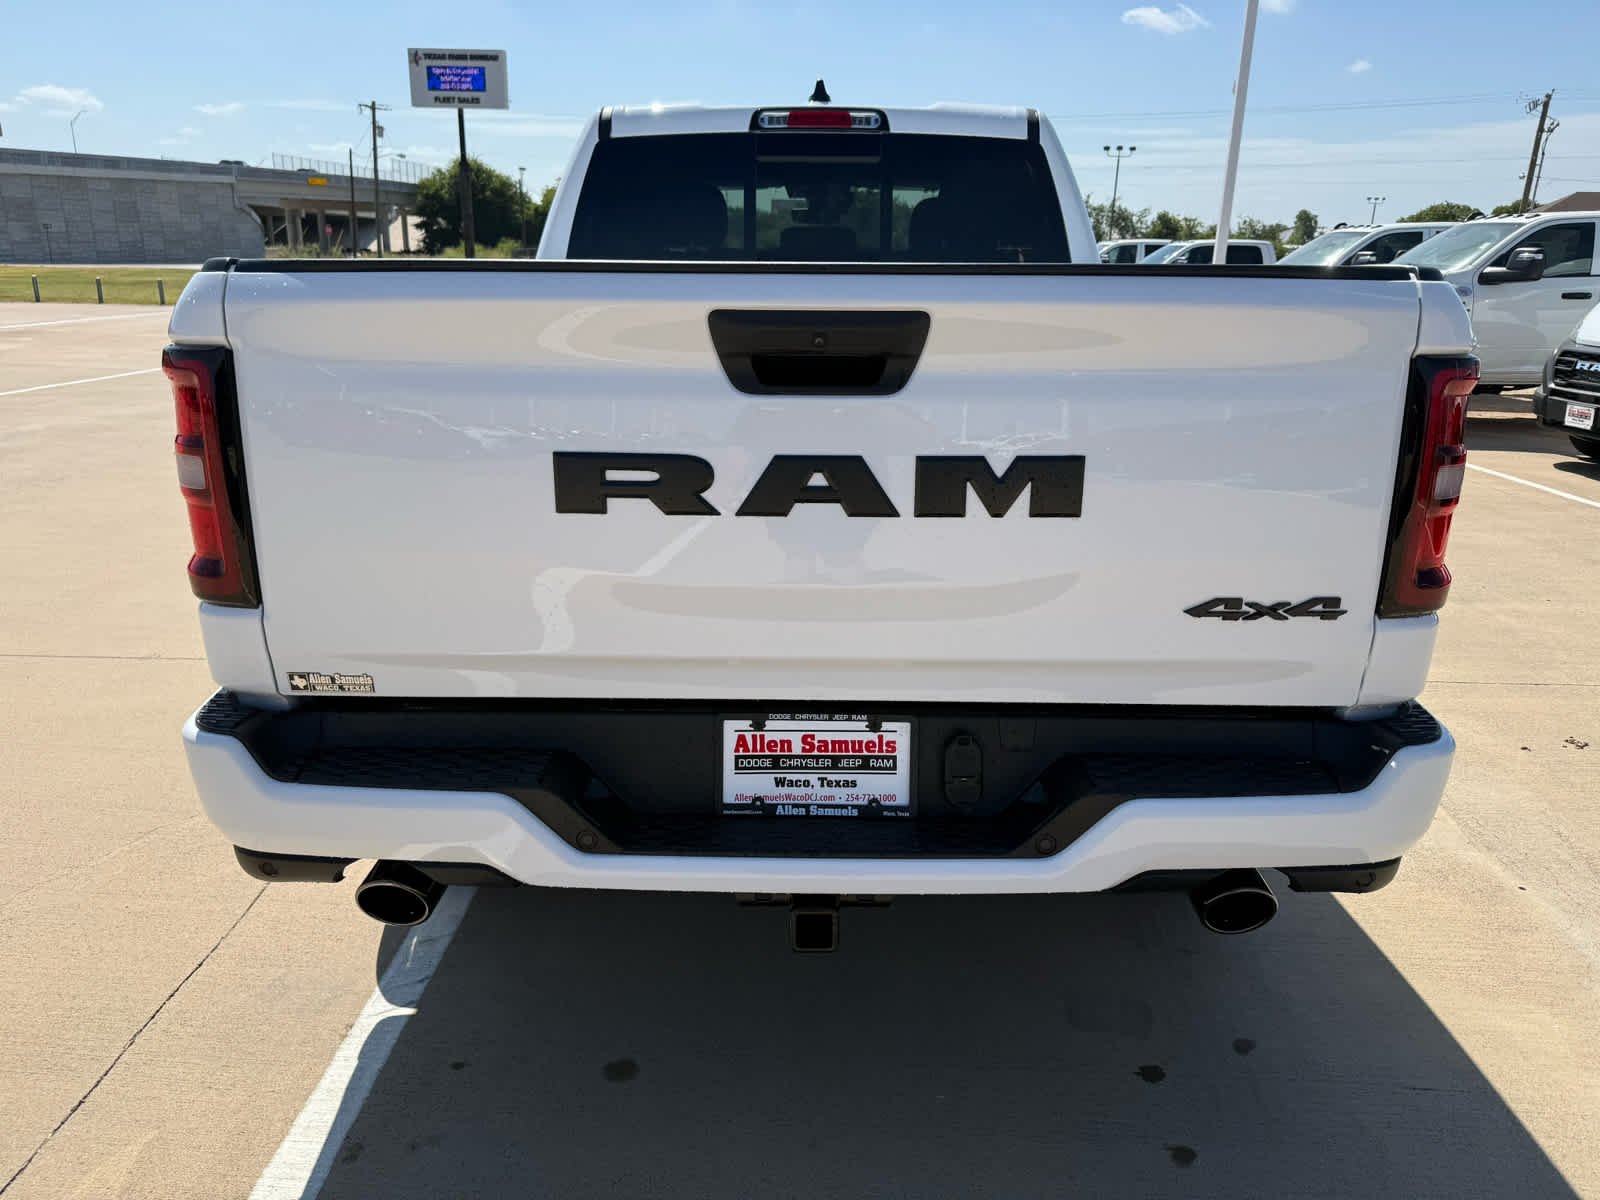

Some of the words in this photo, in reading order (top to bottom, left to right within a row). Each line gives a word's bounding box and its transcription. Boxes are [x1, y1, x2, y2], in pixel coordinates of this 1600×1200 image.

[434, 96, 456, 104] FLEET
[553, 451, 1086, 518] RAM
[1183, 597, 1348, 621] 4x4
[309, 673, 332, 684] Allen
[334, 673, 373, 685] Samuels
[734, 734, 793, 753] Allen
[801, 734, 897, 754] Samuels
[738, 758, 773, 767] DODGE
[779, 758, 832, 768] CHRYSLER
[838, 759, 862, 767] JEEP
[870, 759, 893, 768] RAM
[774, 776, 815, 789] Waco,
[817, 777, 858, 788] Texas
[776, 805, 806, 816] Allen
[809, 805, 859, 816] Samuels
